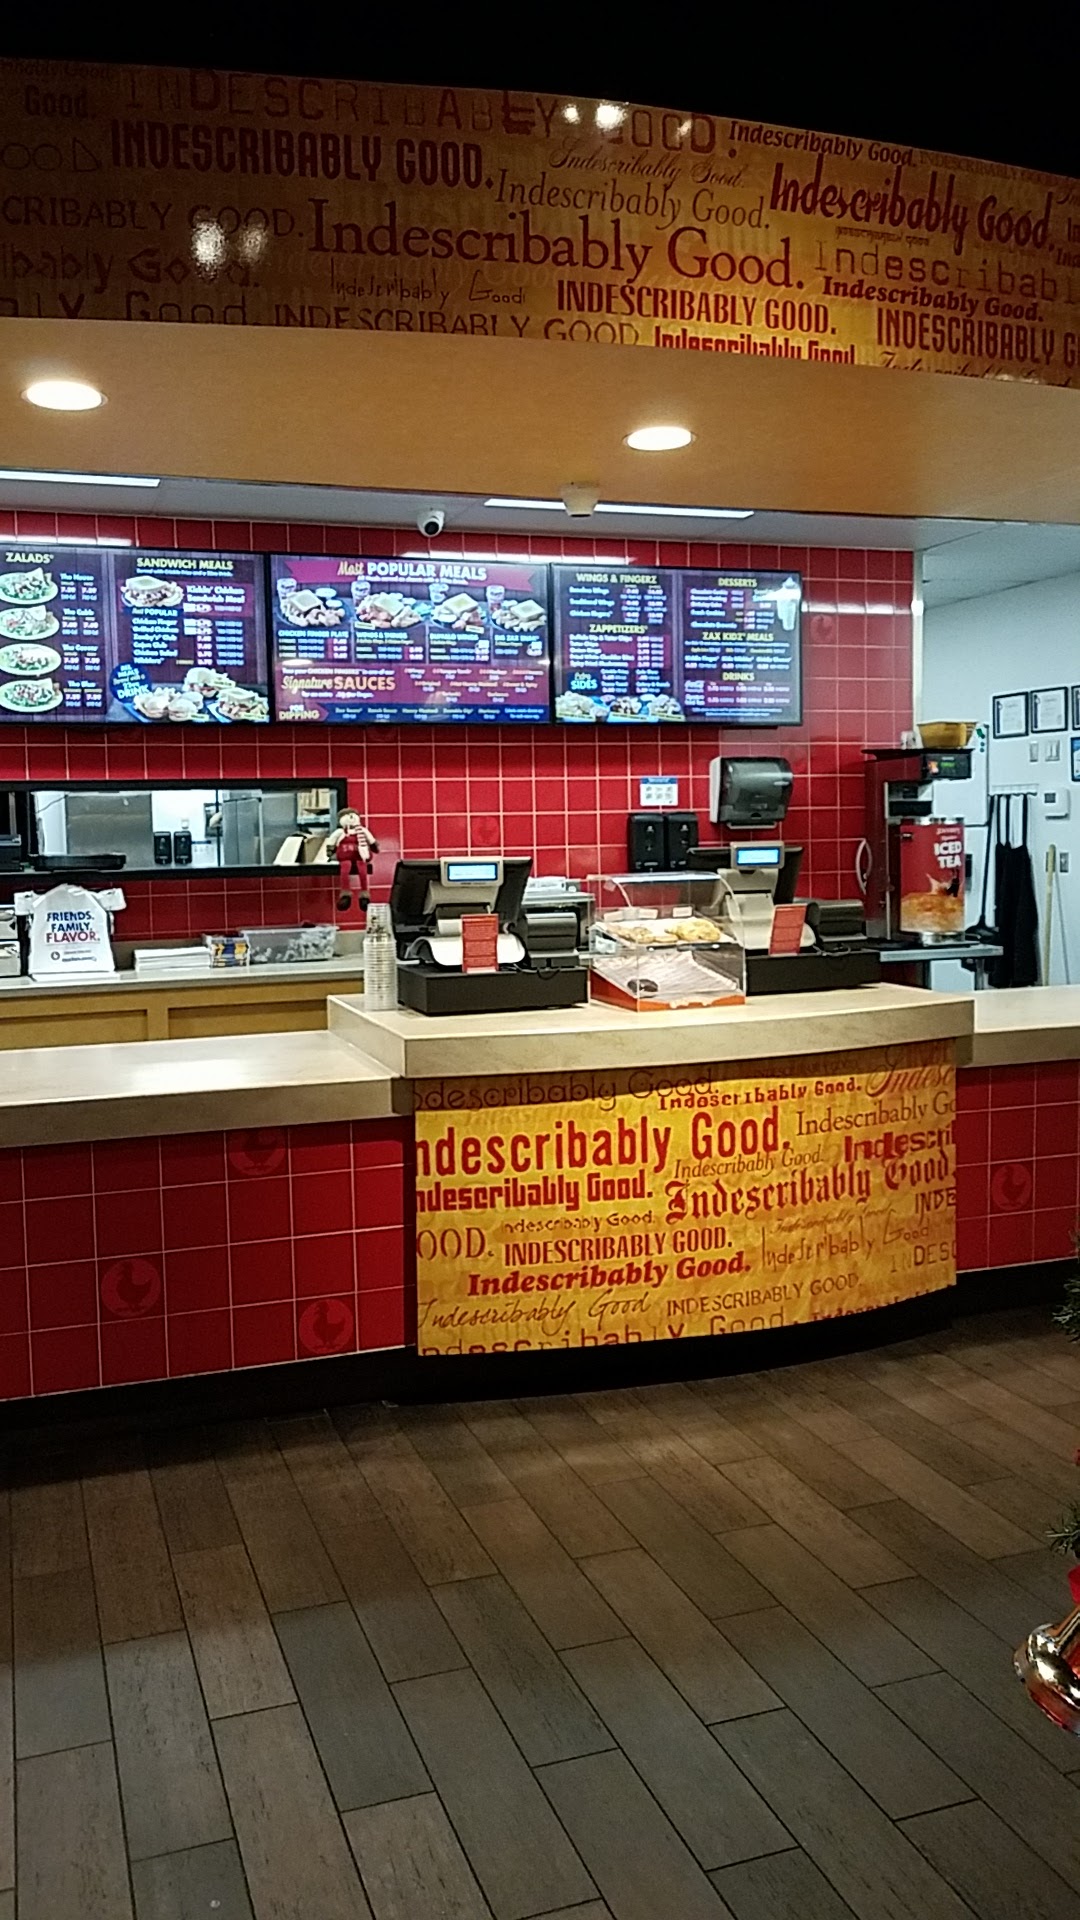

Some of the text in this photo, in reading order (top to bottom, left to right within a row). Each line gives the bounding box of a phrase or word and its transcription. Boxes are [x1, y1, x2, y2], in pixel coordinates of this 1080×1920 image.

[110, 118, 495, 190] INDESCRIBABLY GOOD.
[728, 119, 917, 168] Indescribably Good.
[1, 196, 173, 231] CRIBABLY
[494, 168, 771, 230] Indescribably Good.
[769, 153, 1056, 256] Indescribably Good.
[308, 198, 654, 285] Indescribably
[667, 226, 805, 290] Good.
[330, 257, 450, 311] Indescribably
[822, 275, 1044, 322] Indescribably Good.
[557, 279, 837, 335] INDESCRIBABLY GOOD.
[877, 307, 1055, 366] INDESCRIBABLY
[136, 557, 234, 571] SANDWICH MEALS
[367, 562, 437, 577] POPULAR
[440, 565, 487, 581] MEALS
[576, 573, 609, 582] WINGS
[610, 574, 618, 583] &
[718, 578, 758, 588] DESSERTS
[281, 675, 334, 695] Signature
[333, 676, 396, 691] SAUCES
[570, 679, 599, 691] SIDES
[934, 840, 961, 856] ICED
[938, 854, 962, 869] TEA
[46, 911, 95, 922] FRIENDS.
[50, 921, 93, 933] FAMILY.
[45, 930, 100, 943] FLAVOR.
[628, 1068, 720, 1098] Good.
[658, 1083, 808, 1111] Indescribably
[691, 1105, 791, 1160] Good.
[796, 1095, 929, 1137] Indescribably
[674, 1144, 825, 1179] Indescribably Good.
[587, 1168, 654, 1202] Good.
[664, 1162, 872, 1225] Indescribably
[504, 1226, 733, 1267] INDESCRIBABLY GOOD.
[467, 1250, 751, 1297] Indescribably Good.
[666, 1283, 804, 1317] INDESCRIBABLY
